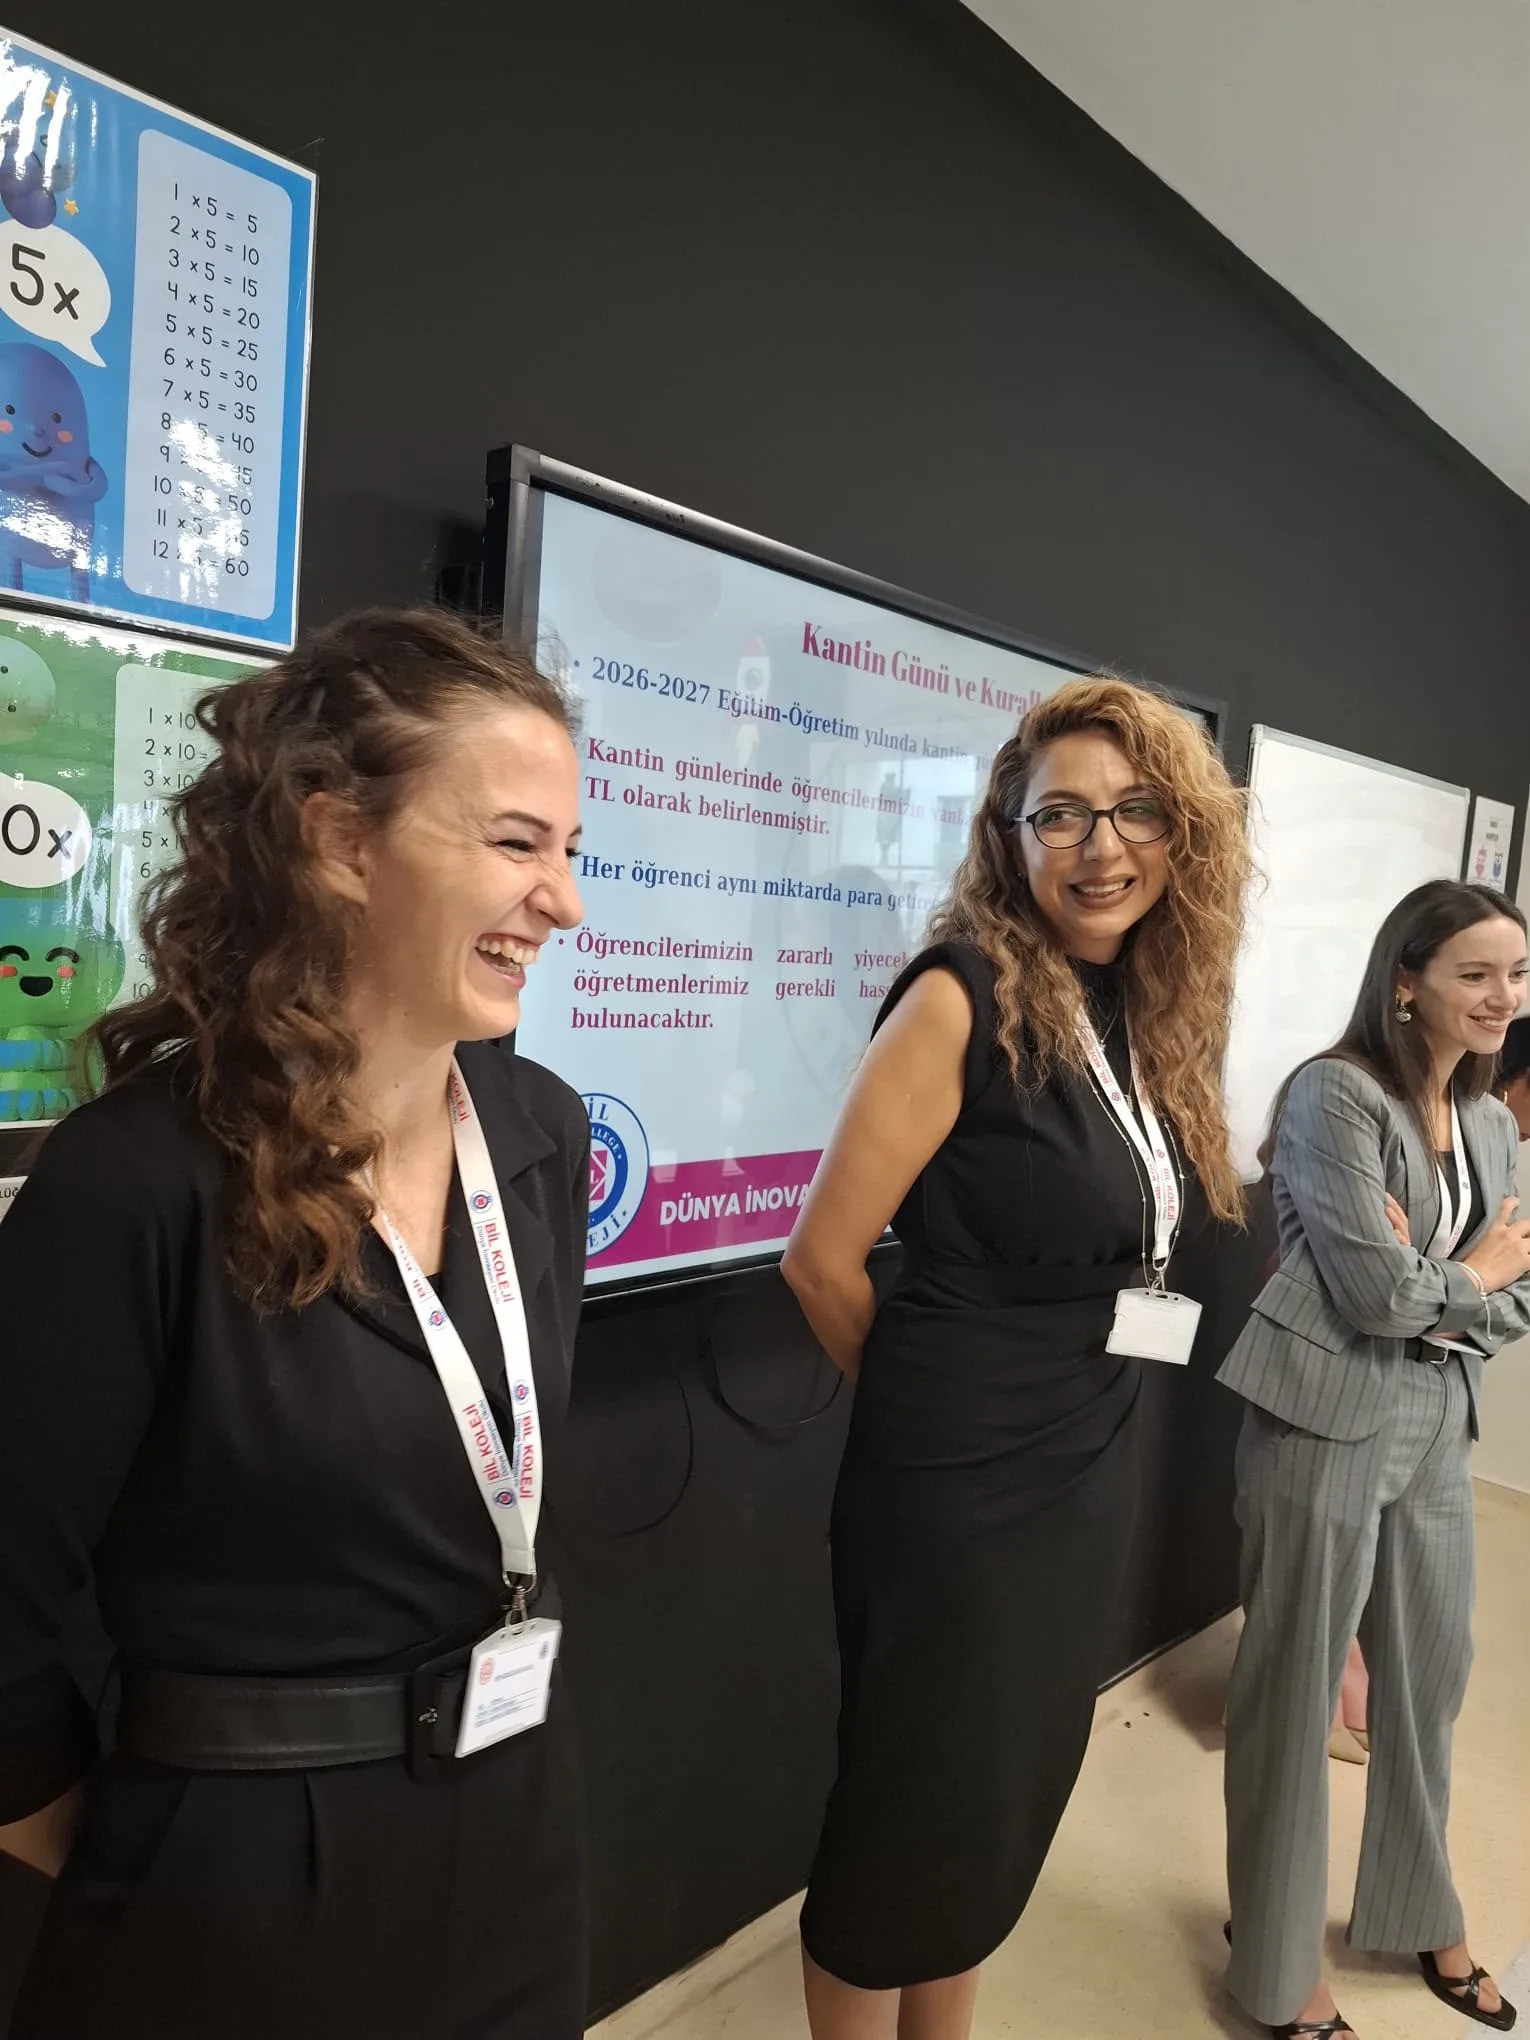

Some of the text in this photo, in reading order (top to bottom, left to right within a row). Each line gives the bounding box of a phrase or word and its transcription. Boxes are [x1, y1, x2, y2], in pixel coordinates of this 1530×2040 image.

[206, 196, 218, 217] 5
[247, 213, 258, 234] 5
[169, 215, 181, 236] 2
[205, 229, 217, 249] 5
[242, 243, 260, 266] 10
[10, 243, 80, 320] 5x
[168, 248, 180, 268] 3
[204, 261, 216, 282] 5
[242, 275, 259, 298] 15
[167, 280, 179, 302] 4
[203, 293, 215, 314] 5
[236, 307, 260, 330] 20
[165, 313, 177, 334] 5
[201, 325, 213, 346] 5
[236, 338, 259, 361] 25
[163, 347, 176, 366] 6
[200, 358, 212, 378] 5
[234, 369, 258, 392] 30
[162, 379, 174, 398] 7
[198, 389, 210, 410] 5
[233, 401, 256, 424] 35
[159, 444, 170, 464] 9
[160, 411, 172, 431] 8
[231, 431, 255, 455] 40
[154, 474, 172, 495] 10
[228, 494, 252, 516] 50
[157, 507, 168, 528] 11
[153, 538, 169, 560] 12
[224, 557, 250, 578] 60
[802, 620, 886, 677] Kantin
[890, 650, 951, 695] Günü
[954, 676, 977, 702] ve
[178, 710, 197, 731] 10
[591, 655, 712, 706] 2026-2027
[716, 687, 860, 741] Eğitim-Öğretim
[864, 726, 918, 755] yılında
[144, 738, 156, 757] 2
[178, 742, 196, 761] 10
[586, 737, 665, 773] Kantin
[674, 755, 784, 794] günlerinde
[143, 768, 155, 788] 3
[585, 776, 830, 836] TL olarak belirlenmiştir.
[141, 830, 153, 849] 5
[139, 861, 152, 880] 6
[580, 855, 626, 881] Her
[631, 859, 712, 889] öğrenci
[716, 872, 758, 897] aynı
[762, 877, 842, 903] miktarda
[846, 888, 883, 908] para
[575, 926, 754, 962] Öğrencilerimizin
[776, 946, 834, 966] zararlı
[573, 968, 750, 998] öğretmenlerimiz
[775, 978, 836, 1001] gerekli
[570, 1006, 714, 1030] bulunacaktır.
[659, 1183, 811, 1226] DÜNYA İNOVA
[485, 1222, 502, 1248] BİL
[462, 1402, 501, 1482] BİL KOLEJİ
[519, 1444, 535, 1498] KOLEJİ
